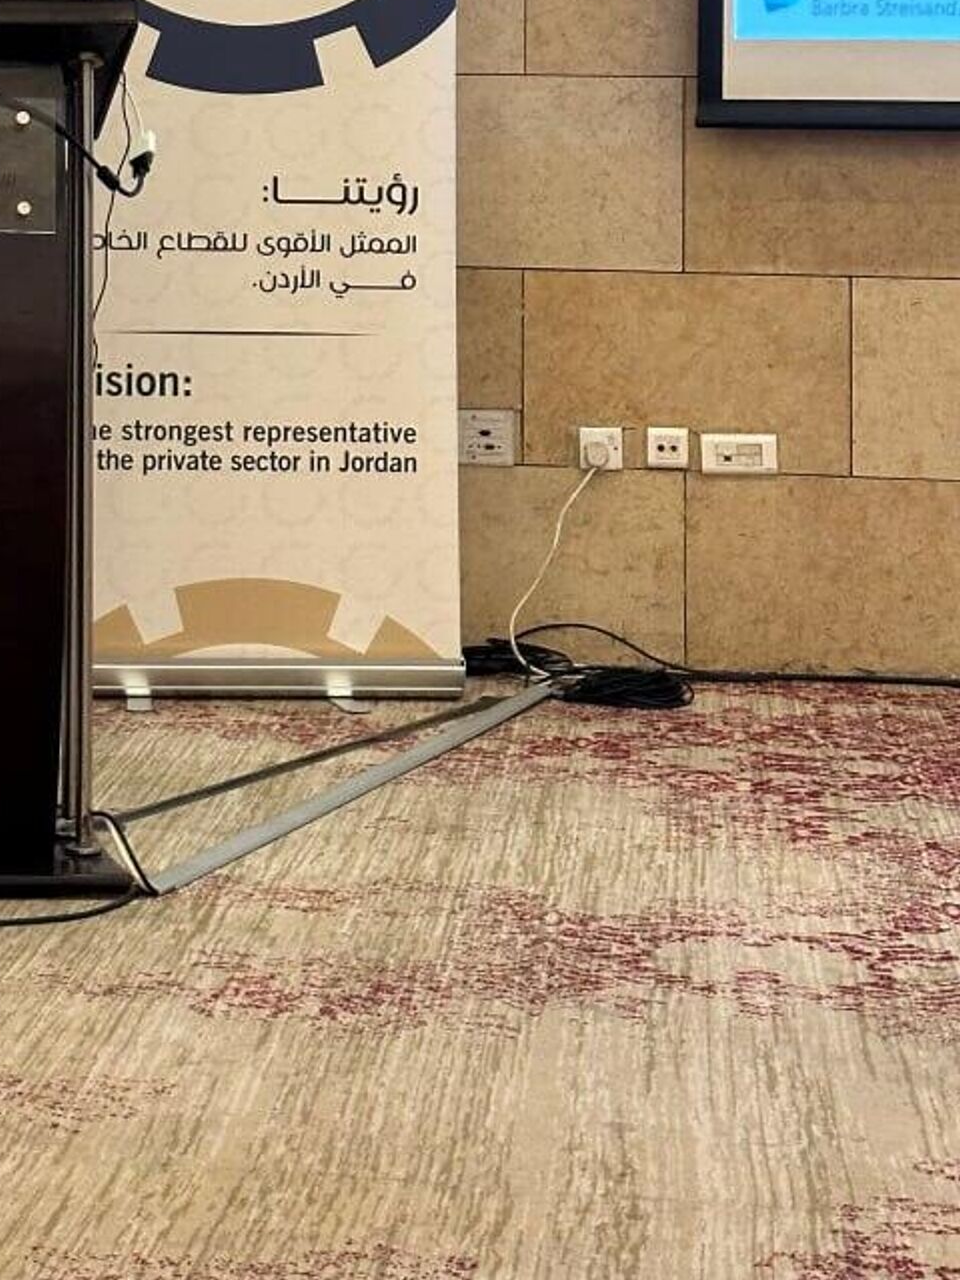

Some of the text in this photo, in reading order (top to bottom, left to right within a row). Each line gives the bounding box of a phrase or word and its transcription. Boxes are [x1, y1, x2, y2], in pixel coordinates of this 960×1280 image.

[156, 231, 248, 260] للقطاع
[256, 228, 331, 256] الأقوى
[340, 231, 417, 258] الممثل
[252, 265, 321, 294] الأردن.
[96, 363, 193, 397] ision:
[121, 420, 234, 447] strongest
[243, 421, 417, 448] representative
[97, 448, 417, 476] the private sector in Jordan
